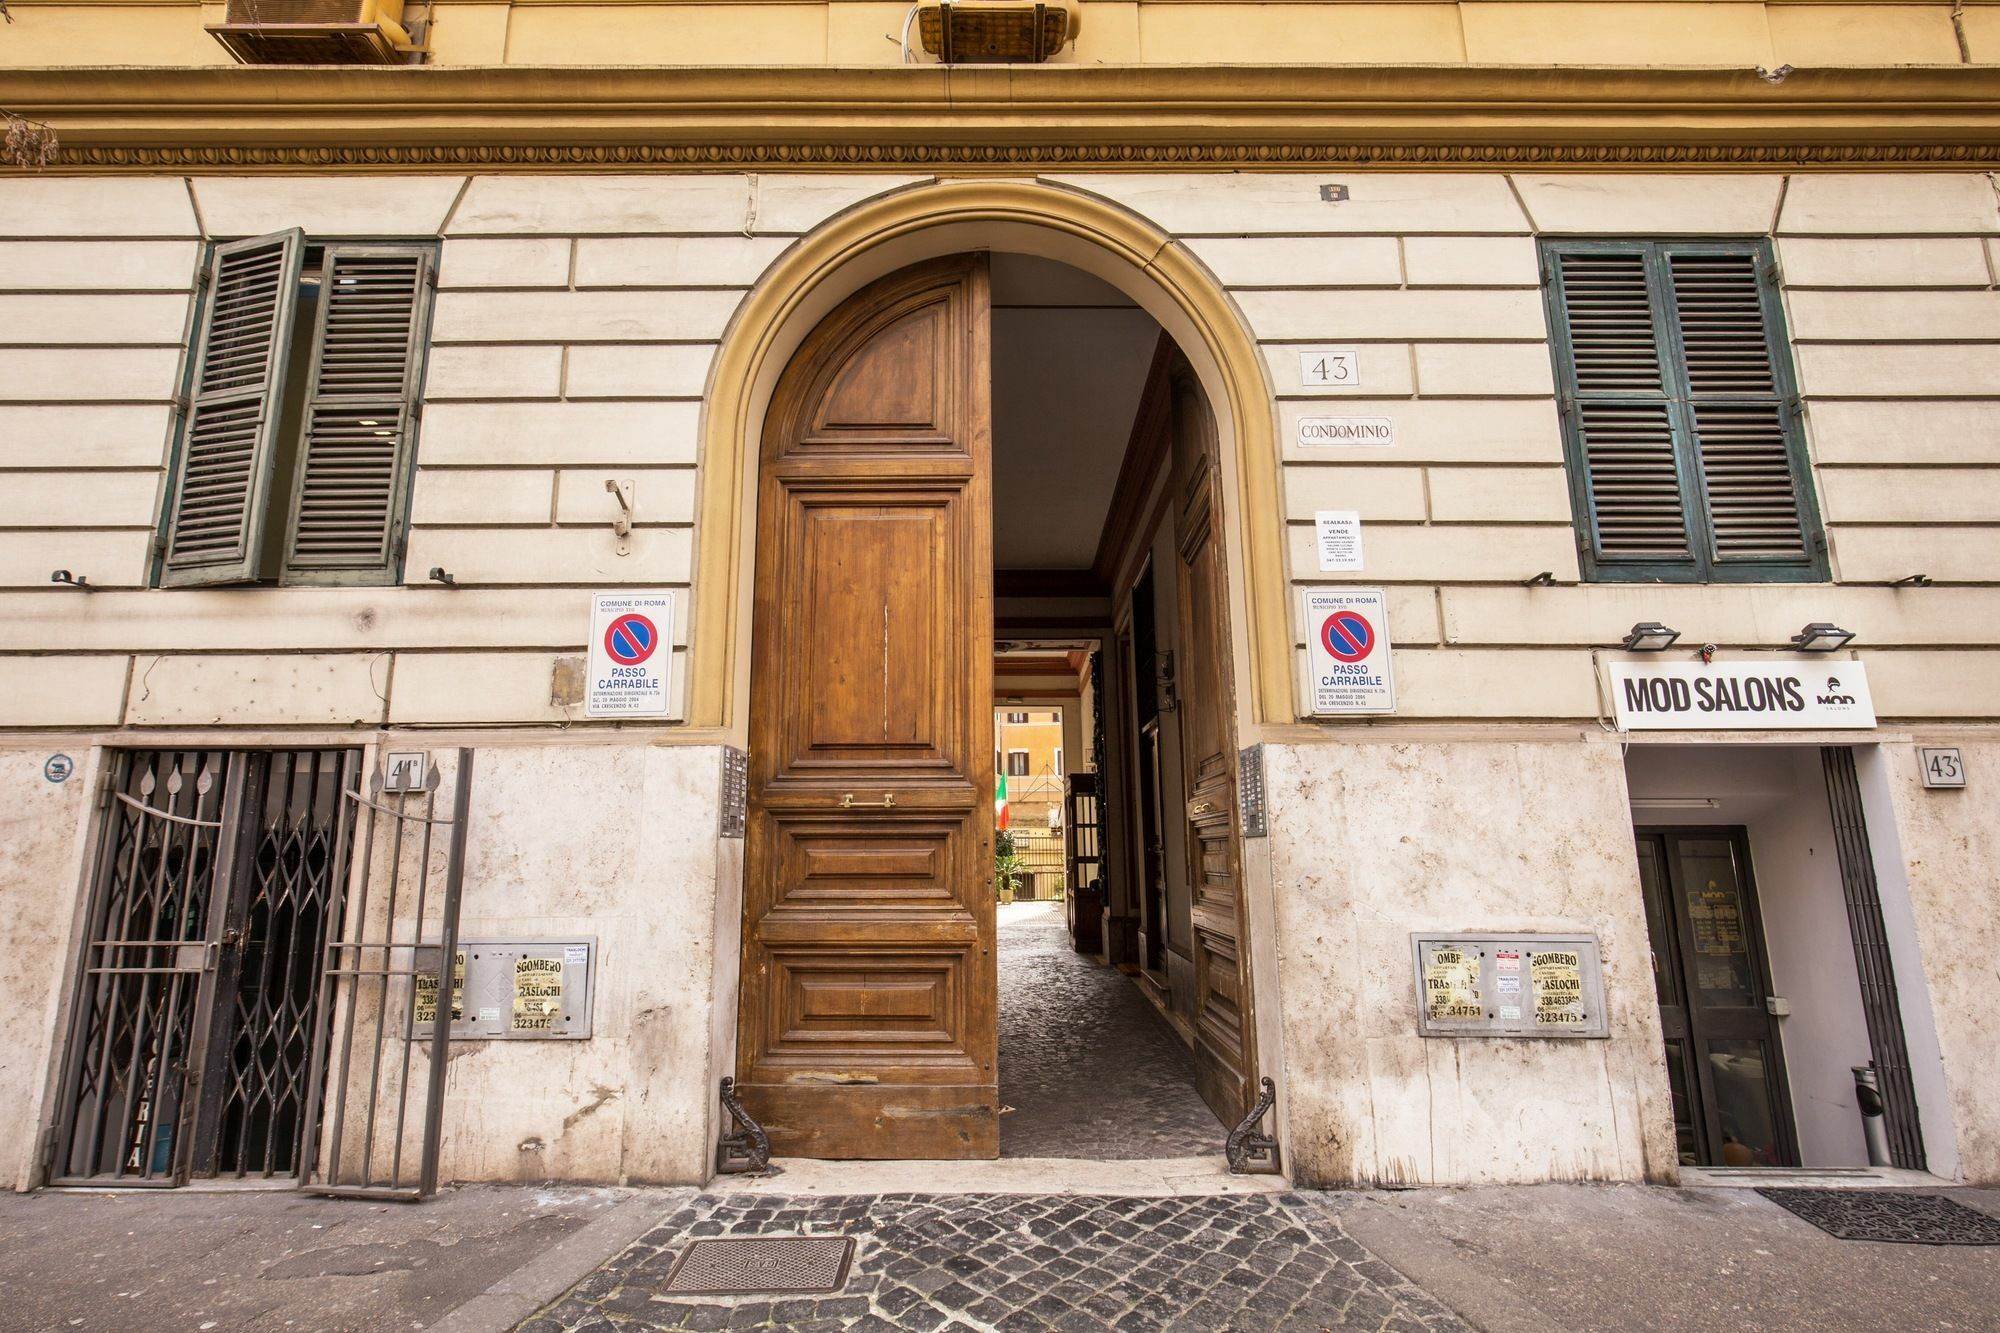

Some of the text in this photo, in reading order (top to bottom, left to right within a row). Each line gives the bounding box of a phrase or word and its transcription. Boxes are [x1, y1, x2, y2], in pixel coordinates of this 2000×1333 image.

[1312, 356, 1348, 380] 43
[1301, 425, 1388, 438] CONDOMINIO
[611, 667, 646, 678] PASSO
[1333, 664, 1368, 675] PASSO
[598, 679, 658, 689] CARRABILE
[1321, 676, 1382, 686] CARRABILE
[1623, 676, 1805, 712] MOD SALONS
[1816, 695, 1855, 704] MOD
[516, 960, 561, 973] SGOMBERO
